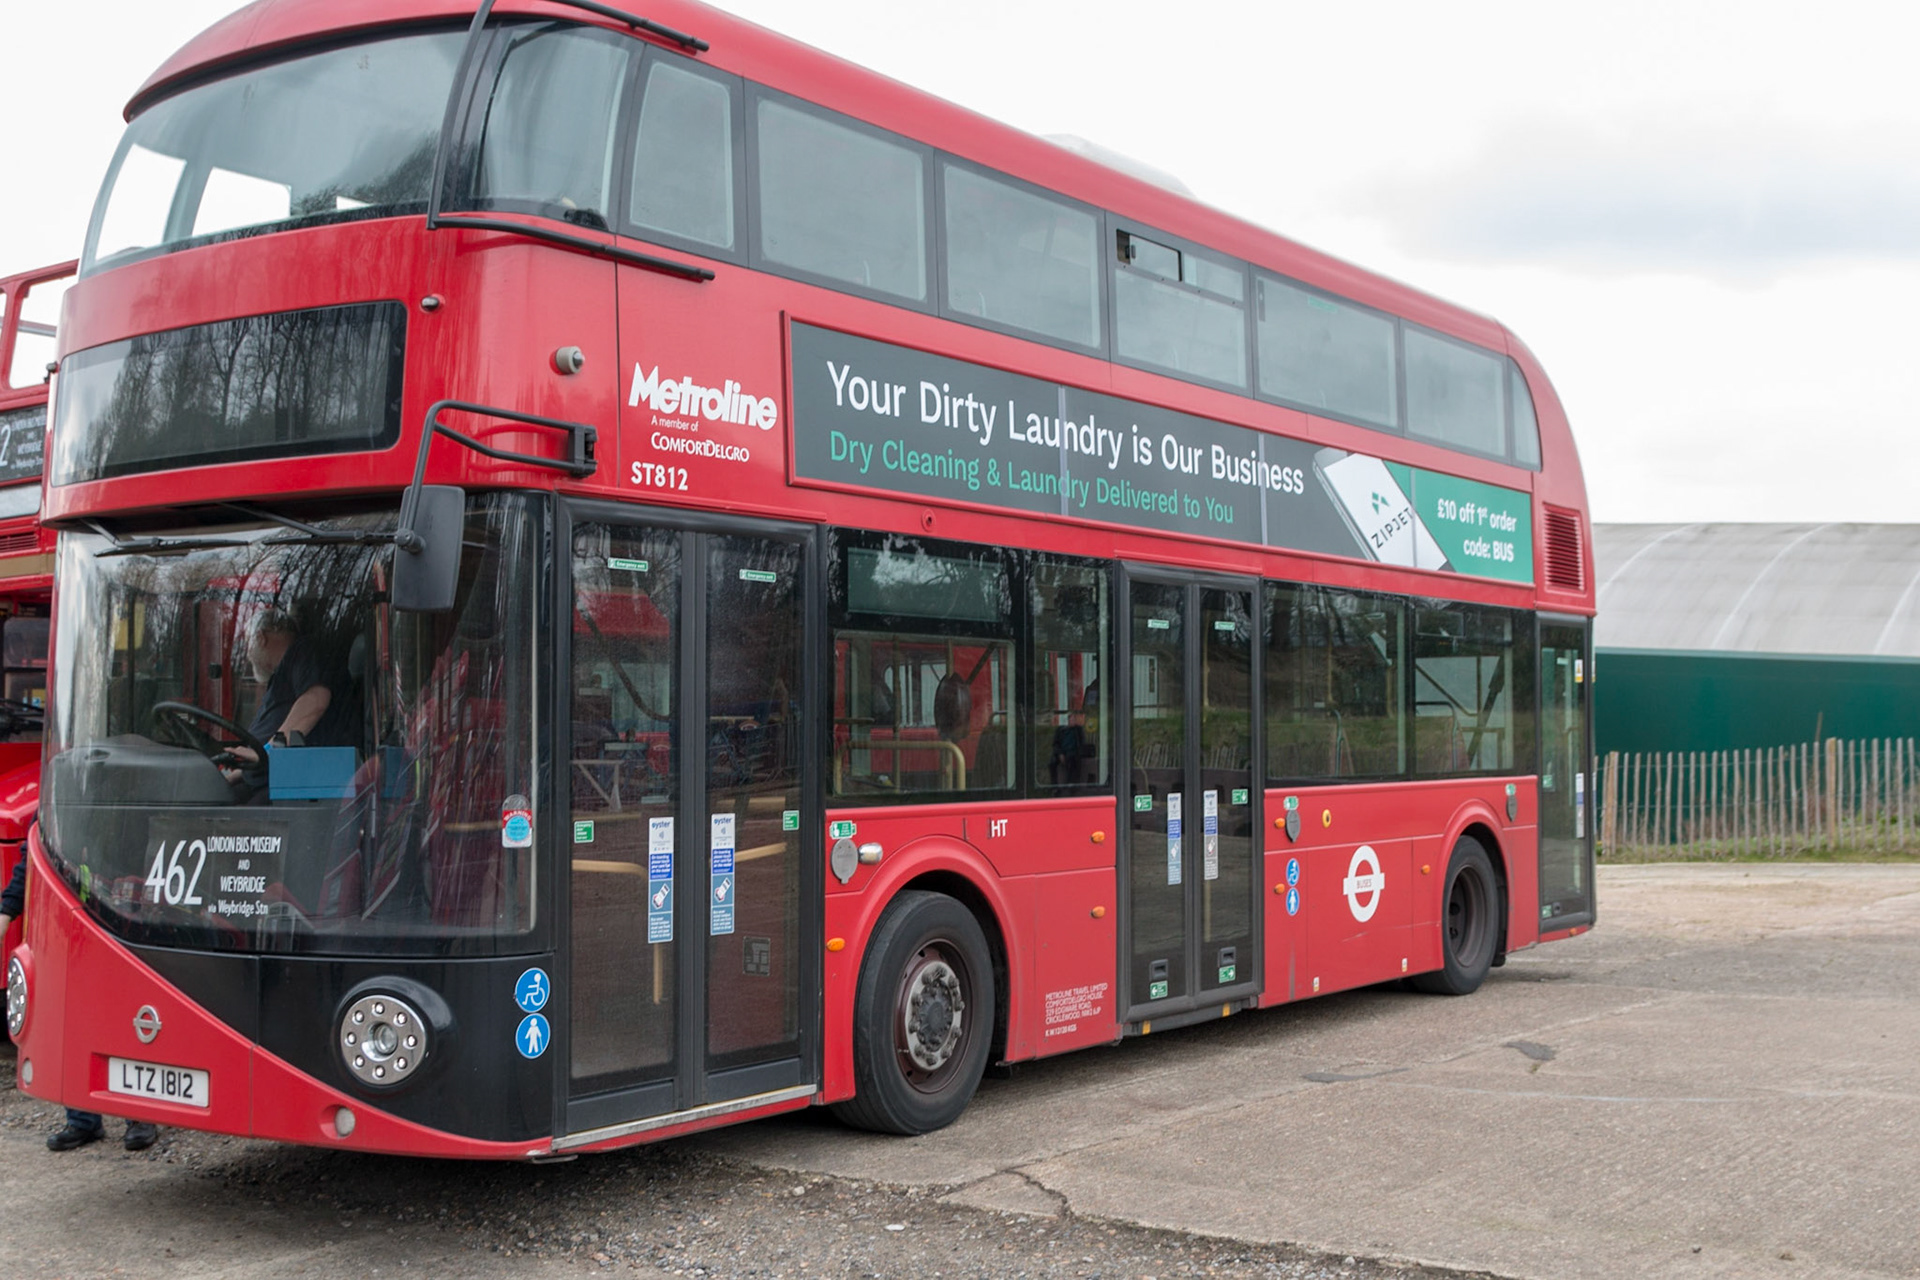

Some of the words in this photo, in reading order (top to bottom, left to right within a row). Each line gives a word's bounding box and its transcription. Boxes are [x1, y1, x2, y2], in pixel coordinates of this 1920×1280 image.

[628, 361, 778, 430] Metroline
[651, 415, 658, 426] A
[659, 418, 689, 431] member
[690, 420, 699, 432] of
[826, 360, 907, 417] Your
[919, 380, 997, 446] Dirty
[1008, 400, 1123, 470] Laundry
[1132, 424, 1152, 466] is
[1161, 433, 1203, 475] Our
[1211, 444, 1304, 495] Business
[630, 461, 689, 491] ST812
[830, 430, 873, 474] Dry
[882, 439, 980, 491] Cleaning
[986, 457, 1001, 487] &
[1008, 461, 1090, 509] Laundry
[1096, 477, 1178, 515] Delivered
[1183, 493, 1201, 519] to
[1205, 496, 1234, 524] You
[1371, 506, 1415, 549] ZIPJET
[1437, 498, 1457, 521] £10
[1459, 502, 1475, 526] off
[1490, 510, 1518, 532] order
[1463, 536, 1491, 559] code:
[1493, 540, 1515, 562] BUS
[991, 819, 1008, 838] HT
[207, 836, 236, 853] LONDON
[236, 836, 250, 853] BUS
[250, 836, 282, 853] MUSEUM
[145, 839, 207, 906] 462
[237, 859, 250, 871] AND
[220, 876, 266, 893] WEYBRIDGE
[208, 904, 217, 914] via
[217, 900, 255, 917] Weybridge
[255, 900, 269, 915] Stn
[123, 1063, 156, 1093] LTZ
[161, 1069, 193, 1099] 1812
